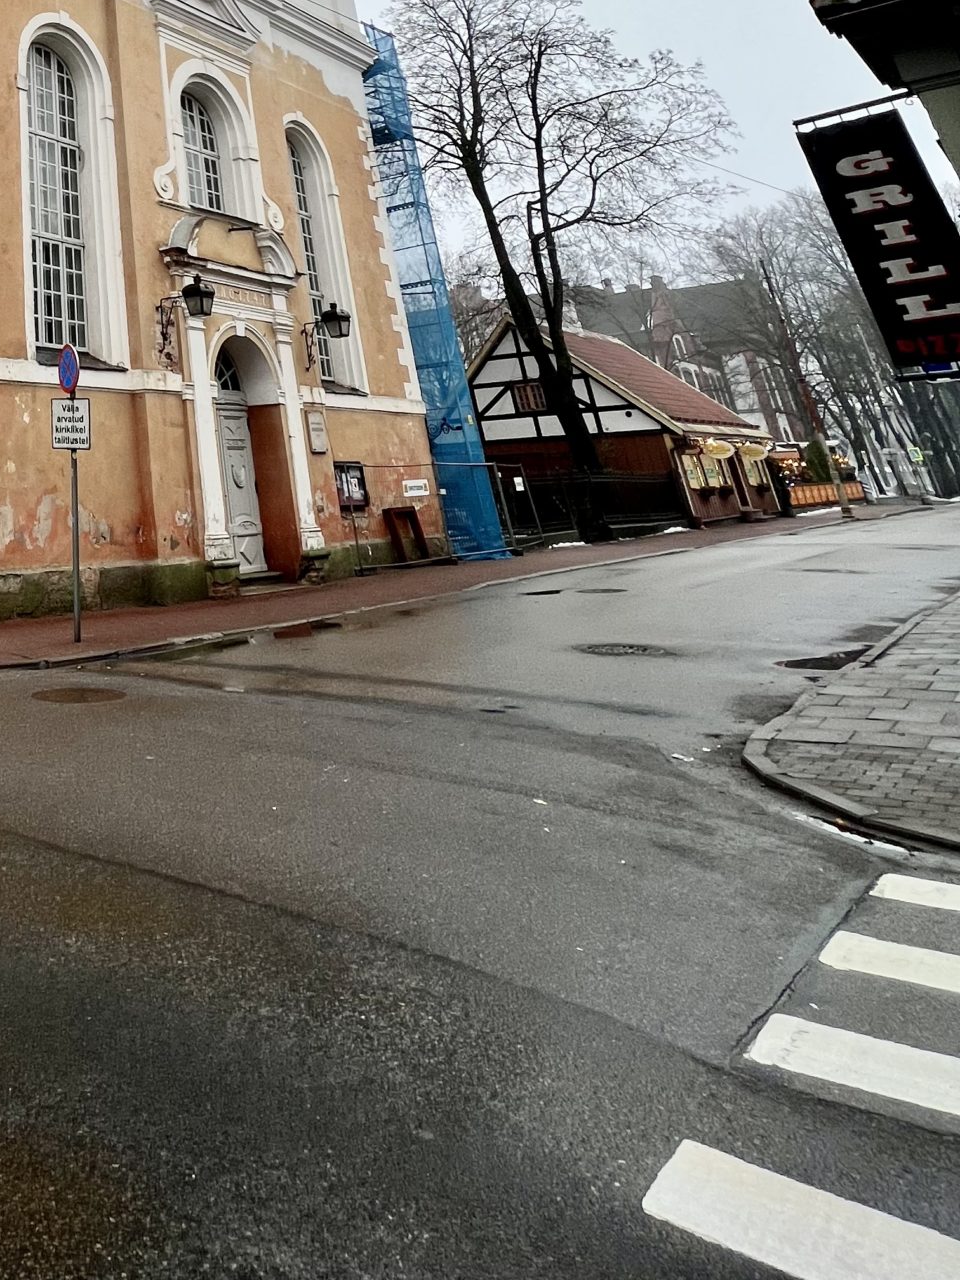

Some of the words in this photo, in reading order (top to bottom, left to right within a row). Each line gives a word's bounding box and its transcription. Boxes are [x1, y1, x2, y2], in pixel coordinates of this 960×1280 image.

[835, 150, 960, 321] GRILL
[61, 404, 80, 415] Välja
[56, 414, 84, 423] arvatud
[55, 425, 86, 434] kiriklikel
